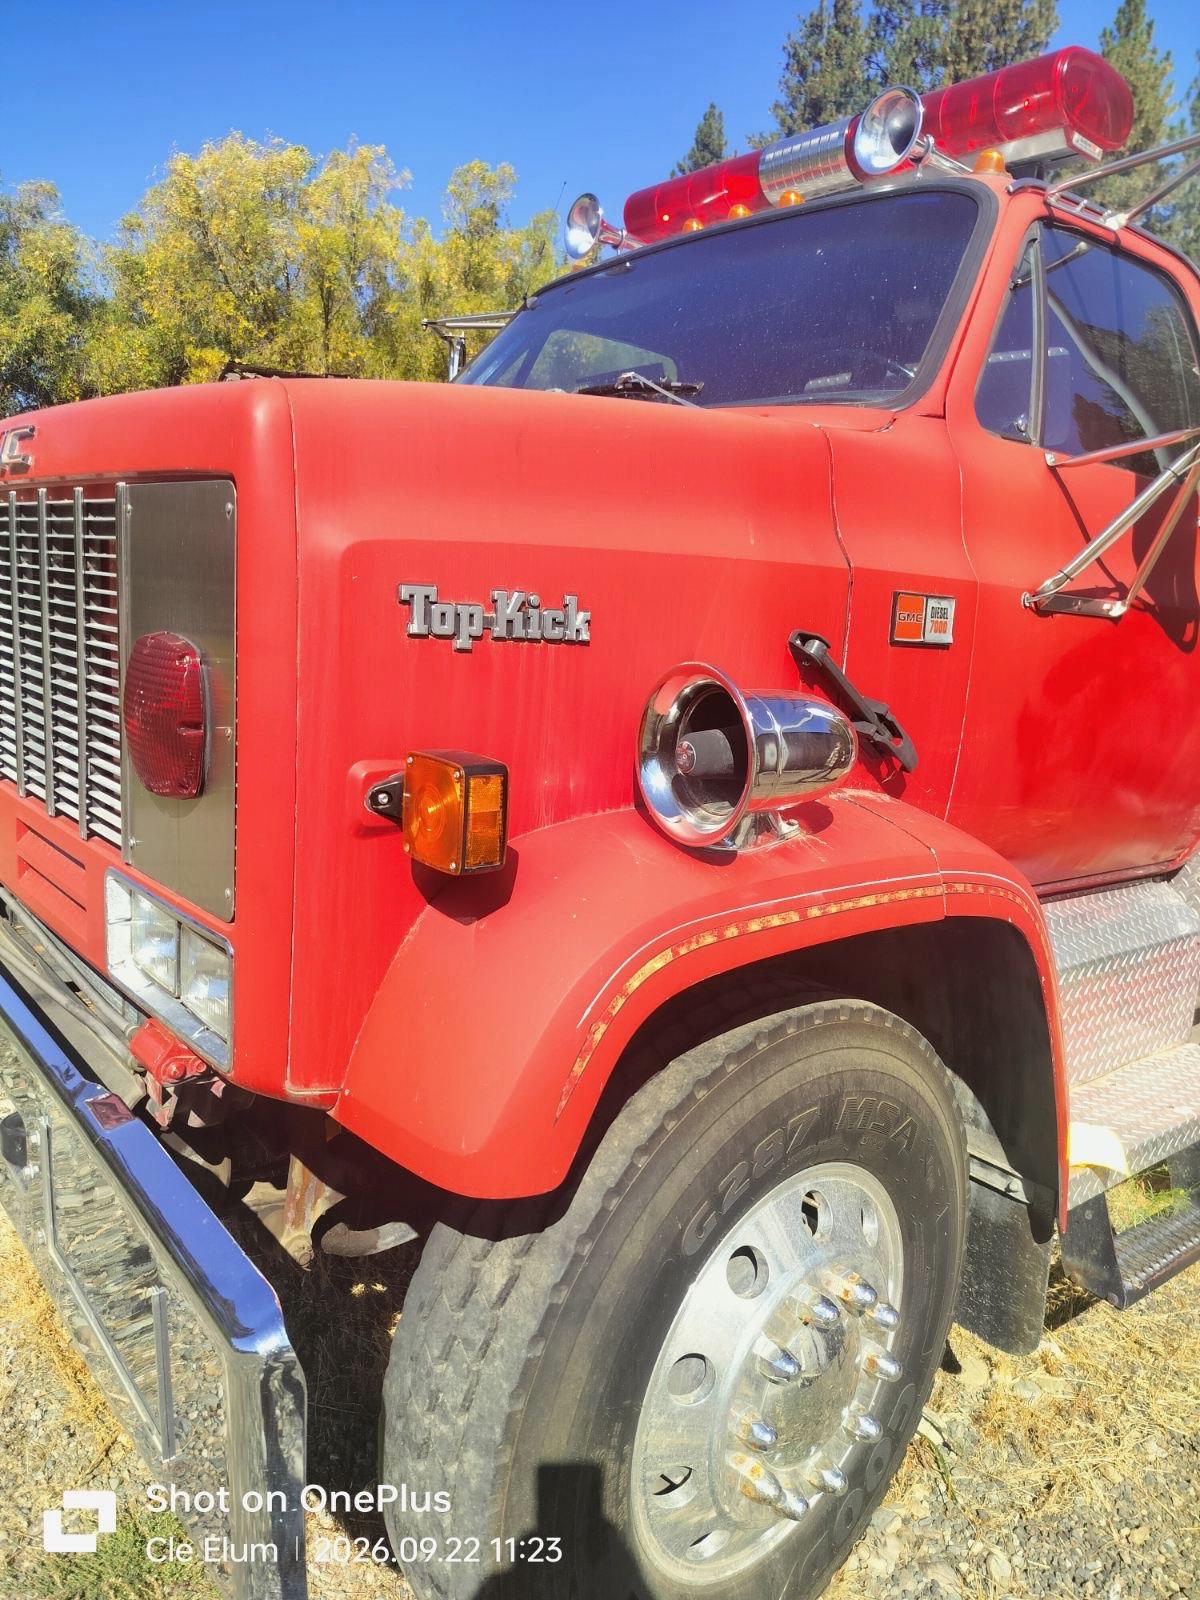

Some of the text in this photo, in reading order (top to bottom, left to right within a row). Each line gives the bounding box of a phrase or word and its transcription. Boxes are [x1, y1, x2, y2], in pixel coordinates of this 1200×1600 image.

[0, 425, 36, 464] C
[898, 611, 923, 623] GMC
[930, 606, 949, 620] DIESEL
[929, 620, 948, 634] 7000
[835, 1096, 920, 1157] MSA
